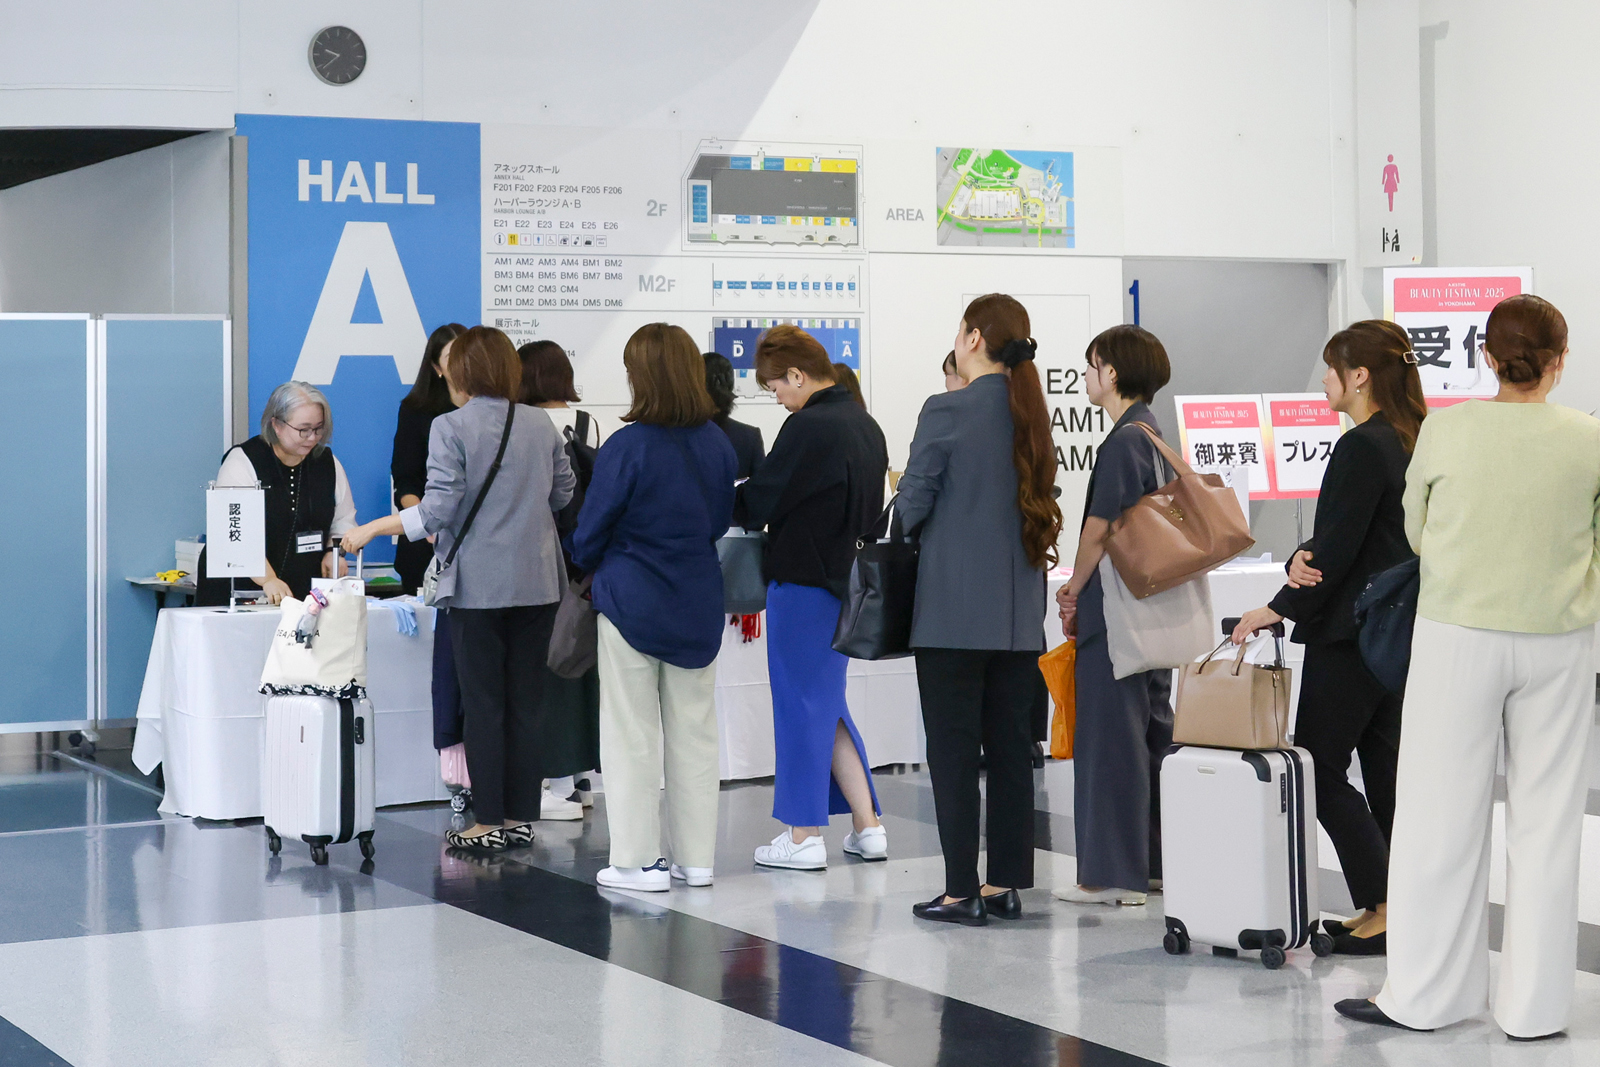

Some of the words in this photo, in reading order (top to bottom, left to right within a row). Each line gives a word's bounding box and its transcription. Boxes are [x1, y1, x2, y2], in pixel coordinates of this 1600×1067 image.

[494, 163, 560, 174] アネックスホール
[298, 159, 435, 205] HALL
[494, 183, 512, 191] F201
[514, 184, 534, 192] F202
[537, 184, 556, 193] F203
[559, 185, 579, 193] F204
[581, 185, 601, 194] F205
[603, 186, 623, 194] F206
[646, 199, 668, 217] 2F
[886, 208, 925, 221] AREA
[494, 219, 508, 227] E21
[515, 220, 530, 228] E22
[537, 220, 553, 228] E23
[559, 221, 574, 229] E24
[581, 221, 597, 229] E25
[603, 222, 619, 230] E26
[494, 258, 512, 266] AM1
[515, 258, 534, 266] AM2
[538, 258, 557, 267] AM3
[560, 259, 579, 267] AM4
[582, 259, 601, 267] BM1
[604, 259, 623, 268] BM2
[494, 271, 512, 279] BM3
[515, 271, 534, 279] BM4
[538, 271, 557, 280] BM5
[560, 272, 579, 280] BM6
[582, 272, 601, 280] BM7
[604, 272, 623, 281] BM8
[515, 285, 534, 293] CM2
[538, 285, 557, 293] CM3
[560, 285, 579, 293] CM4
[638, 274, 676, 293] M2F
[1410, 288, 1441, 299] BEAUTY
[1445, 288, 1481, 298] FESTIVAL
[1484, 287, 1505, 298] 2025
[289, 221, 430, 386] A
[494, 298, 512, 306] DM1
[515, 298, 534, 306] DM2
[538, 298, 557, 307] DM3
[560, 299, 579, 307] DM4
[582, 299, 601, 307] DM5
[604, 299, 623, 307] DM6
[495, 317, 540, 328] 展示ホール
[733, 344, 744, 358] D
[842, 345, 853, 357] A
[1047, 369, 1086, 394] E2
[1195, 441, 1259, 465] 御来賓
[1282, 440, 1333, 462] プレス
[229, 503, 242, 542] 認定校
